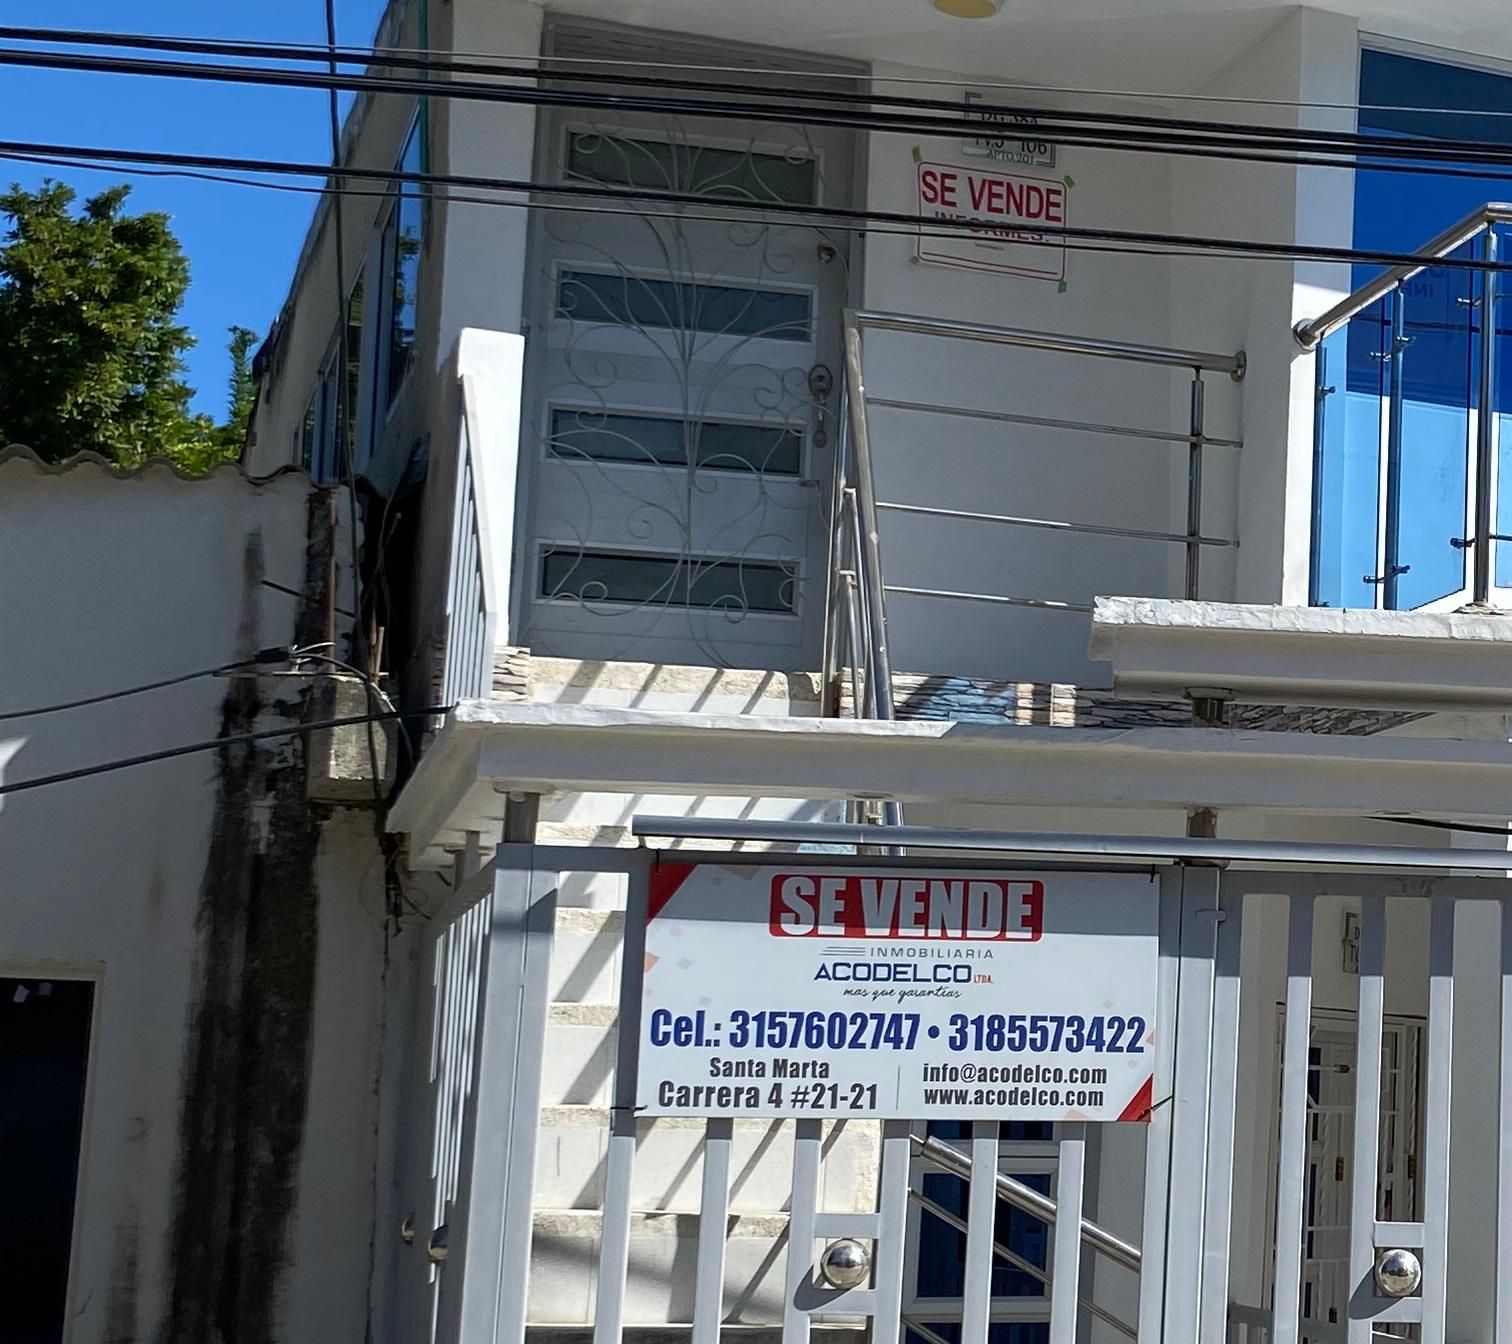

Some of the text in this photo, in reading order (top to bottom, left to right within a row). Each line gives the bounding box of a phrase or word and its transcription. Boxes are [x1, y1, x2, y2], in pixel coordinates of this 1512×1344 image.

[921, 170, 1062, 223] SE VENDE
[780, 876, 1033, 939] SE VENDE
[870, 947, 994, 959] INMOBILIARIA
[813, 962, 972, 983] ACODELCO
[872, 987, 896, 1001] que
[650, 1008, 1146, 1054] Cel.: 3157602747 3185573422
[709, 1057, 830, 1079] Santa Marta
[923, 1063, 1108, 1084] info@acodelco.com
[658, 1080, 878, 1110] Carrera 4 #21-21
[924, 1087, 1104, 1107] www.acodelco.com
